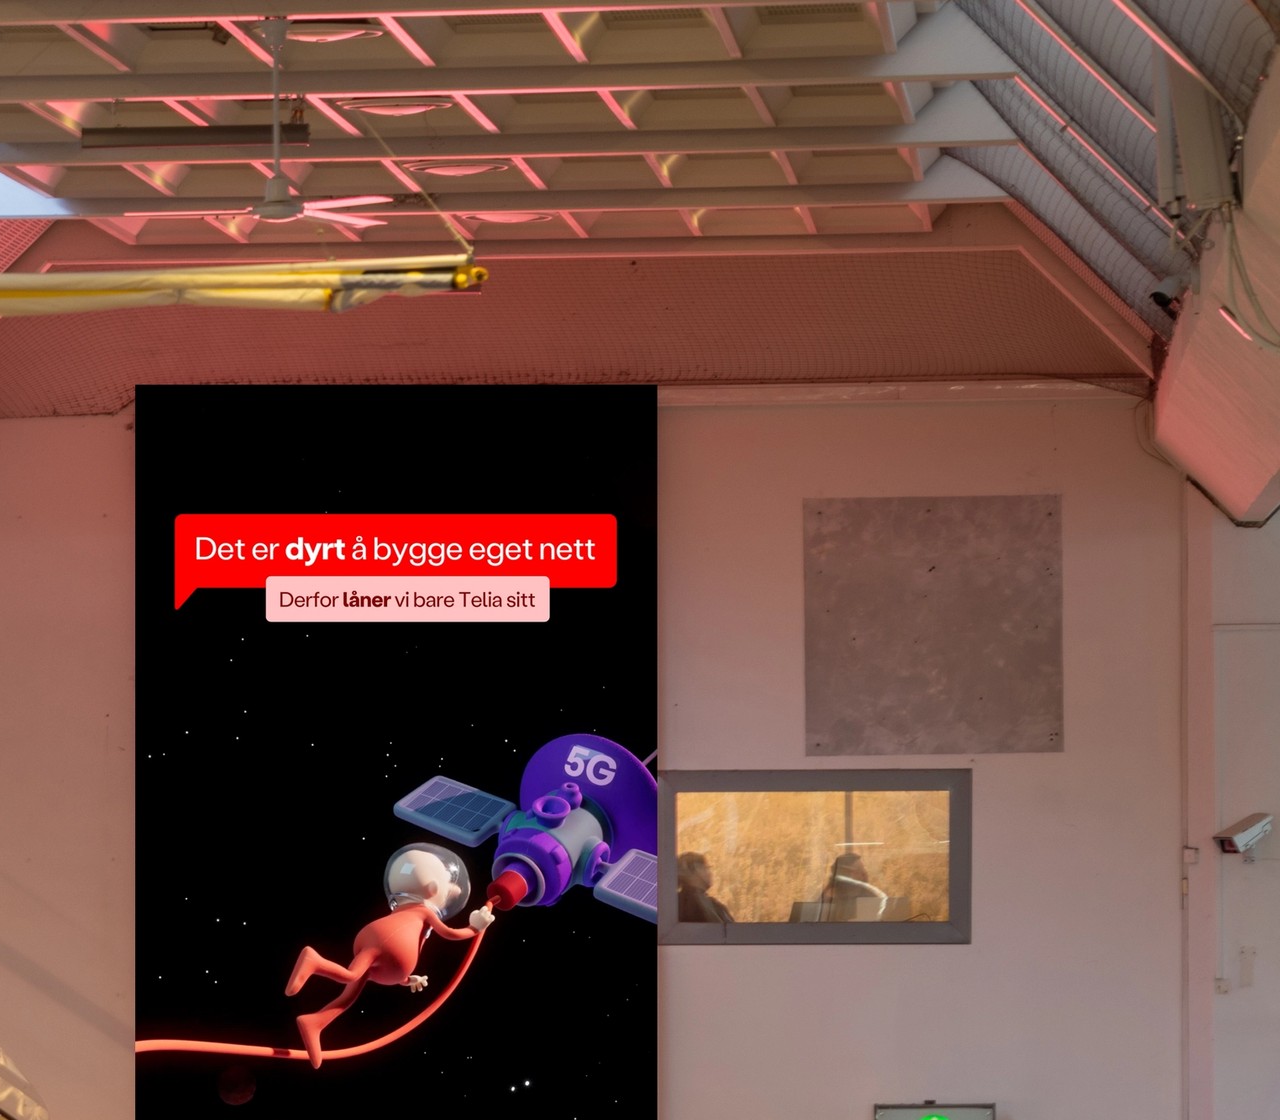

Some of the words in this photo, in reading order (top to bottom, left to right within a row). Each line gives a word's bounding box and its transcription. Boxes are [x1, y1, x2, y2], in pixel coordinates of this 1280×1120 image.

[195, 536, 246, 561] Det
[252, 541, 280, 561] er
[285, 536, 346, 567] dyrt
[351, 535, 368, 561] å
[374, 536, 463, 567] bygge
[469, 538, 533, 567] eget
[539, 538, 596, 561] nett
[279, 591, 340, 608] Derfor
[343, 591, 392, 608] låner
[394, 591, 410, 608] vi
[414, 591, 455, 608] bare
[458, 591, 503, 608] Telia
[506, 591, 536, 608] sitt
[564, 745, 617, 786] 5G
